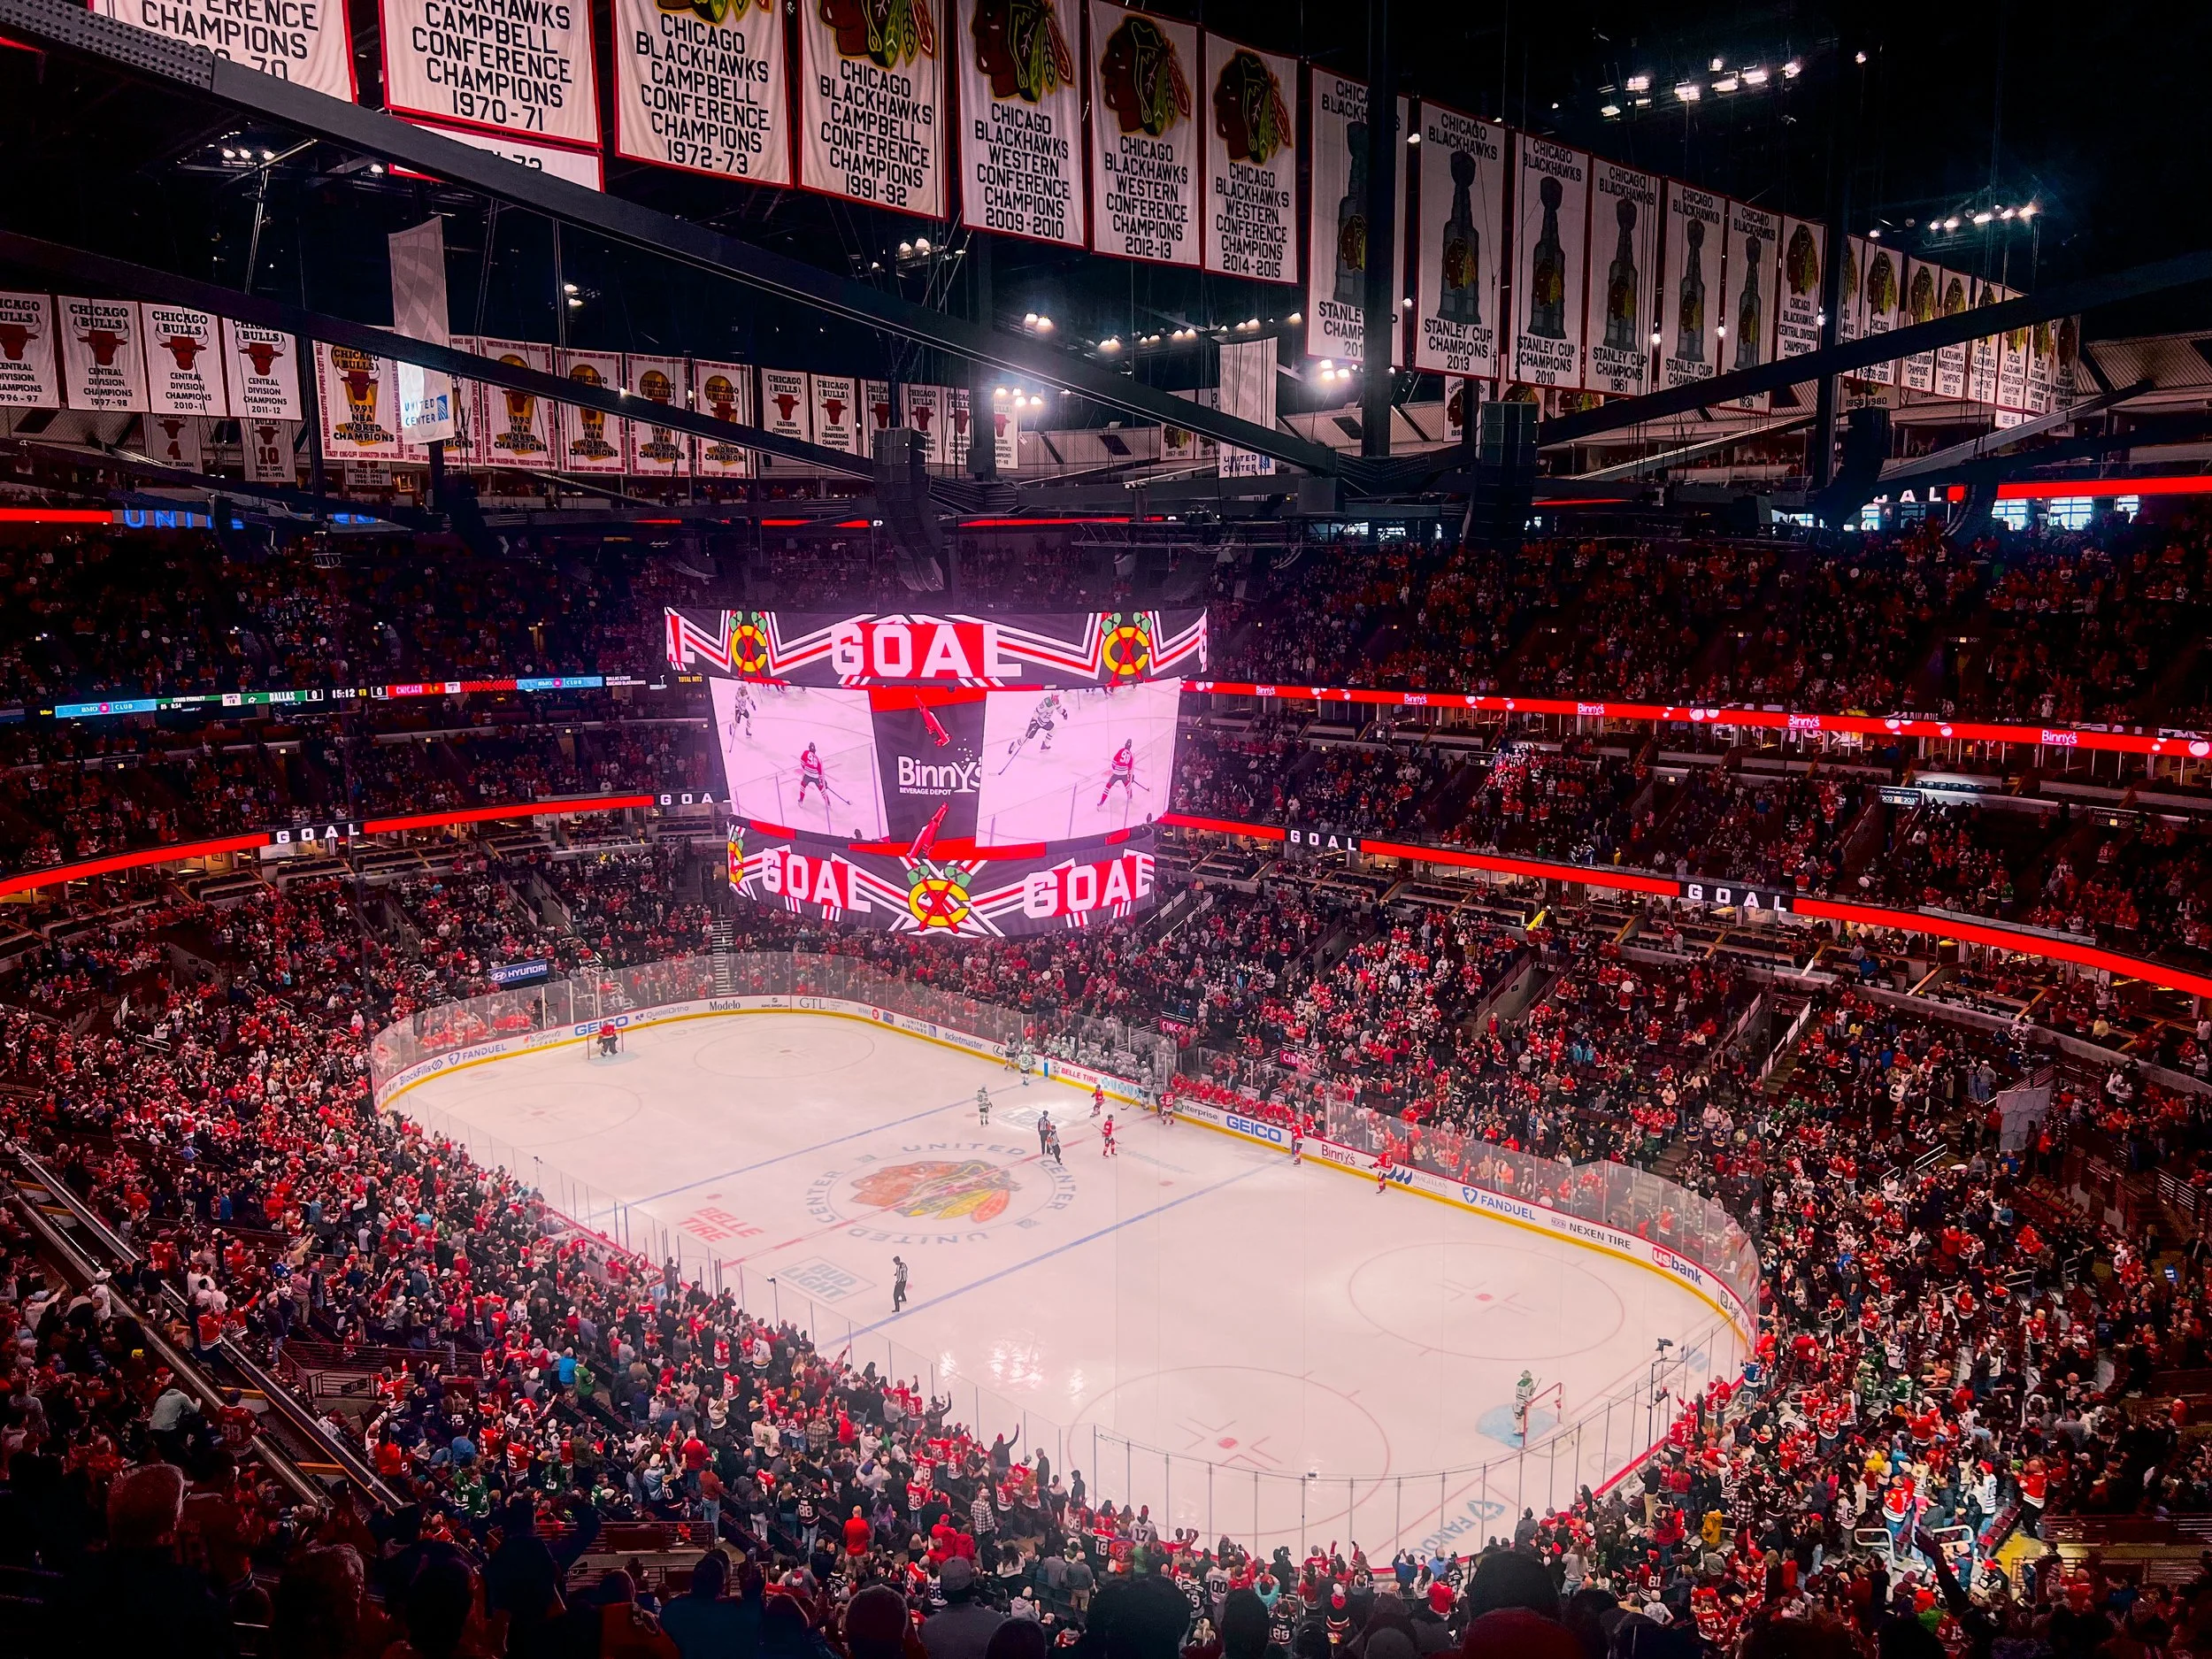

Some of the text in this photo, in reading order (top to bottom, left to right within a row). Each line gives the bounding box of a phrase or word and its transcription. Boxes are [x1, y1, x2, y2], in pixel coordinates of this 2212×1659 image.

[142, 1, 307, 59] CHAMPIONS
[426, 2, 557, 54] CAMPBELL
[661, 13, 745, 54] CHICAGO
[412, 27, 572, 83] CONFERENCE
[636, 31, 768, 83] BLACKHAWKS
[426, 58, 563, 108] CHAMPIONS
[651, 61, 758, 105] CAMPBELL
[841, 61, 910, 98] CHICAGO
[453, 89, 543, 131] 1970-71
[641, 84, 770, 131] CONFERENCE
[820, 75, 933, 126] BLACKHAWKS
[831, 103, 920, 145] CAMPBELL
[991, 103, 1051, 135] CHICAGO
[1441, 113, 1487, 142] CHICAGO
[652, 111, 762, 153] CHAMPIONS
[974, 120, 1069, 160] BLACKHAWKS
[1428, 127, 1498, 160] BLACKHAWKS
[820, 121, 930, 168] CONFERENCE
[1119, 136, 1173, 163] CHICAGO
[1532, 139, 1572, 164] CHICAGO
[667, 139, 748, 175] 1972-73
[830, 147, 923, 188] CHAMPIONS
[988, 145, 1059, 177] WESTERN
[1104, 151, 1188, 185] BLACKHAWKS
[1524, 151, 1582, 182] BLACKHAWKS
[976, 163, 1071, 200] CONFERENCE
[1228, 162, 1276, 188] CHICAGO
[1609, 166, 1646, 189] CHICAGO
[845, 177, 907, 207] 1991-92
[1116, 174, 1179, 203] WESTERN
[1216, 178, 1289, 208] BLACKHAWKS
[1599, 178, 1655, 206] BLACKHAWKS
[1682, 188, 1713, 209] CHICAGO
[984, 187, 1064, 220] CHAMPIONS
[1106, 194, 1188, 223] CONFERENCE
[1225, 200, 1279, 226] WESTERN
[1672, 199, 1720, 224] BLACKHAWKS
[986, 207, 1064, 240] 2009-2010
[1112, 214, 1183, 242] CHAMPIONS
[1216, 214, 1287, 243] CONFERENCE
[1125, 235, 1171, 258] 2012-13
[1221, 234, 1283, 261] CHAMPIONS
[1223, 254, 1281, 278] 2014-2015
[69, 303, 128, 318] CHICAGO
[152, 311, 208, 325] CHICAGO
[81, 317, 122, 328] BULLS
[163, 324, 202, 335] BULLS
[1424, 318, 1494, 343] STANLEY CUP
[242, 330, 280, 342] BULLS
[1428, 336, 1488, 359] CHAMPIONS
[1517, 335, 1575, 357] STANLEY CUP
[342, 360, 374, 371] BULLS
[1447, 355, 1470, 372] 2013
[1520, 352, 1572, 373] CHAMPIONS
[1593, 346, 1628, 365] STANLEY
[170, 373, 203, 381] CENTRAL
[1535, 370, 1555, 385] 2010
[1596, 364, 1643, 380] CHAMPIONS
[1665, 358, 1695, 374] STANLEY
[1698, 365, 1713, 377] CUP
[88, 378, 125, 387] DIVISION
[171, 382, 205, 391] DIVISION
[248, 378, 280, 387] CENTRAL
[768, 374, 801, 385] CHICAGO
[774, 384, 797, 393] BULLS
[817, 380, 849, 389] CHICAGO
[1611, 378, 1628, 393] 1961
[83, 388, 133, 396] CHAMPIONS
[165, 392, 212, 402] CHAMPIONS
[243, 396, 287, 405] CHAMPIONS
[248, 387, 281, 396] DIVISION
[251, 405, 281, 414] 2011-12
[349, 404, 373, 413] 1991
[334, 433, 395, 442] CHAMPIONS
[345, 422, 381, 432] WORLD
[832, 623, 1022, 679] GOAL
[269, 692, 296, 702] DALLAS
[311, 690, 317, 699] 0
[332, 688, 355, 698] 15:12
[377, 687, 382, 695] 0
[396, 685, 423, 694] CHICAGO
[276, 824, 358, 844] GOAL
[1291, 830, 1357, 851] GOAL
[763, 848, 871, 912] GOAL
[1024, 854, 1149, 918] GOAL
[1688, 885, 1786, 911] GOAL
[508, 964, 547, 978] HYUNDAI
[646, 1005, 689, 1019] QuidelOrtho
[710, 1000, 741, 1011] Modelo
[799, 997, 826, 1010] GTL
[902, 1024, 927, 1034] AIRLINES
[907, 1019, 927, 1028] UNITED
[1162, 1021, 1178, 1032] CIBC
[463, 1044, 507, 1060] FANDUEL
[945, 1033, 983, 1049] ticketmaster
[400, 1065, 431, 1086] BlockFills
[1061, 1067, 1098, 1084] BELLE TIRE
[1174, 1101, 1218, 1120] nterprise
[1226, 1115, 1282, 1143] GEICO
[902, 1143, 1026, 1156] UNITED
[1040, 1159, 1076, 1210] CENTER
[1414, 1174, 1448, 1188] MAGELLAN
[807, 1171, 843, 1224] CENTER
[1480, 1195, 1536, 1221] FANDUEL
[678, 1217, 733, 1242] TIRE
[694, 1207, 764, 1237] BELLE
[1570, 1223, 1631, 1249] NEXEN TIRE
[779, 1267, 847, 1298] LIGHT
[809, 1263, 857, 1287] BUD
[1135, 1529, 1149, 1542] 17
[1210, 1579, 1227, 1594] 00
[1647, 1576, 1661, 1587] 81
